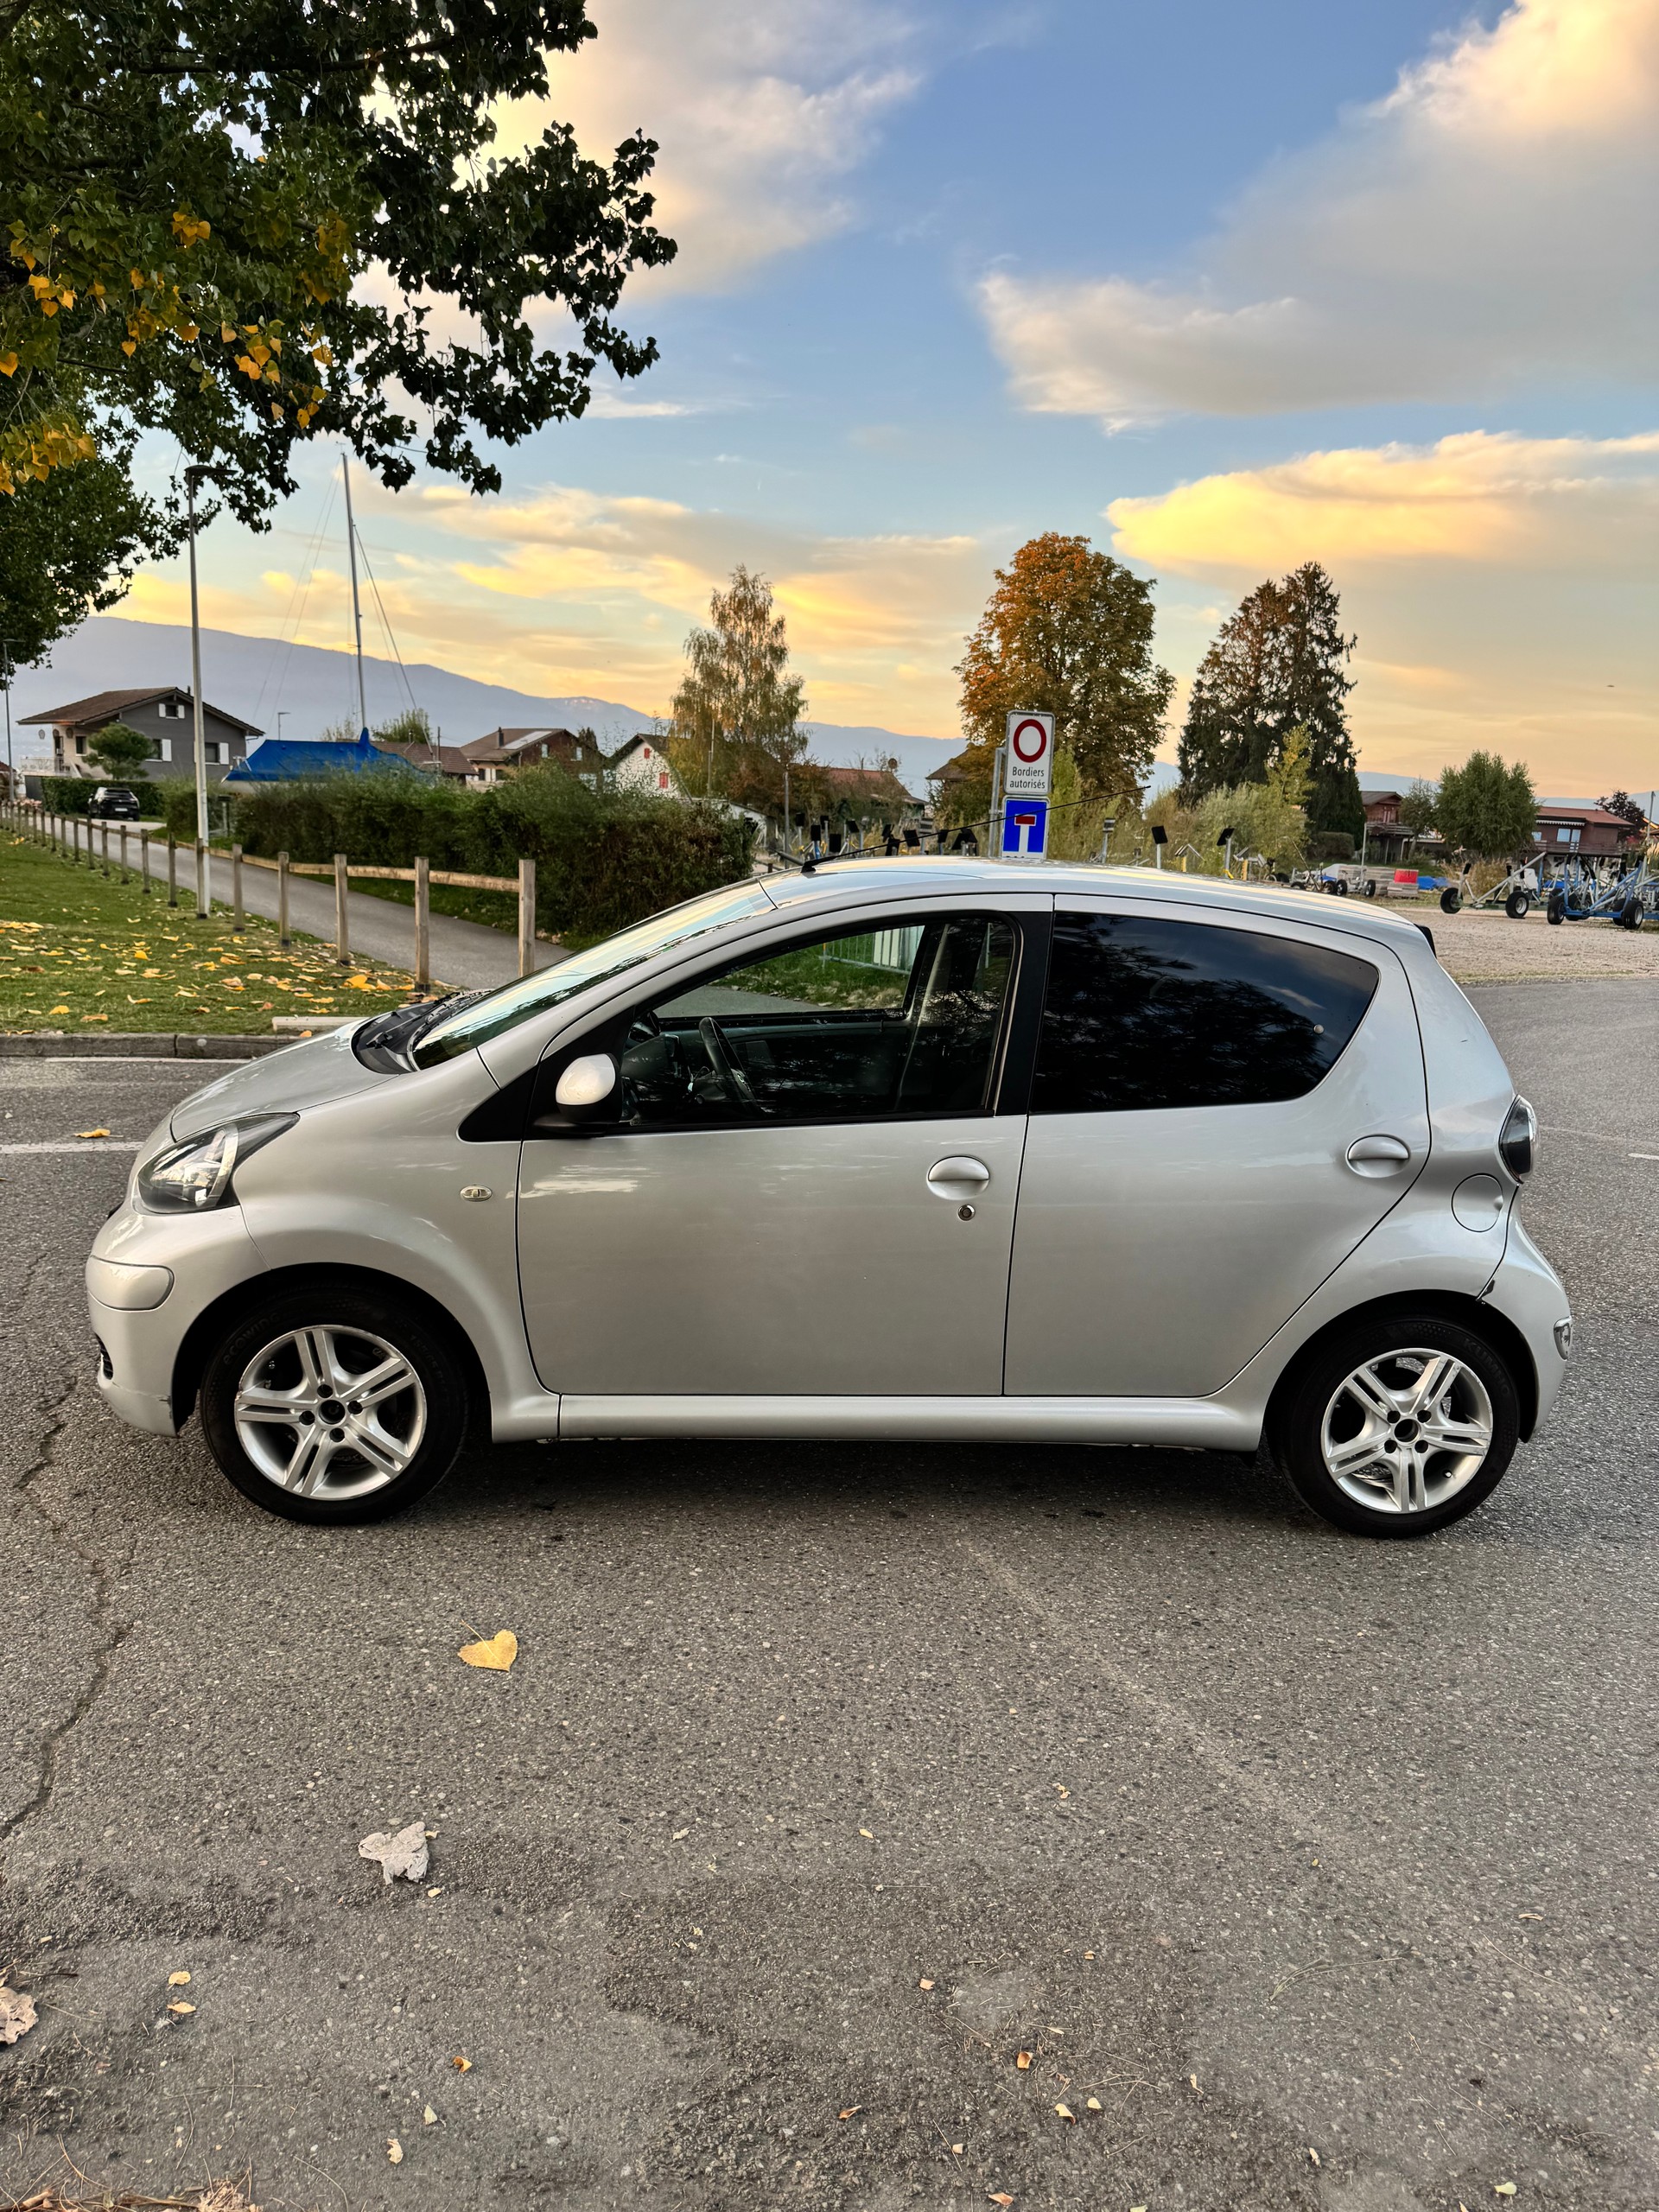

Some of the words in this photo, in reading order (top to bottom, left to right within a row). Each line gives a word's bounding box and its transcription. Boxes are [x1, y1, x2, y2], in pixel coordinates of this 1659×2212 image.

[1012, 766, 1045, 777] Bordiers
[1009, 779, 1046, 789] autorisés
[1464, 1338, 1510, 1396] KUMHO
